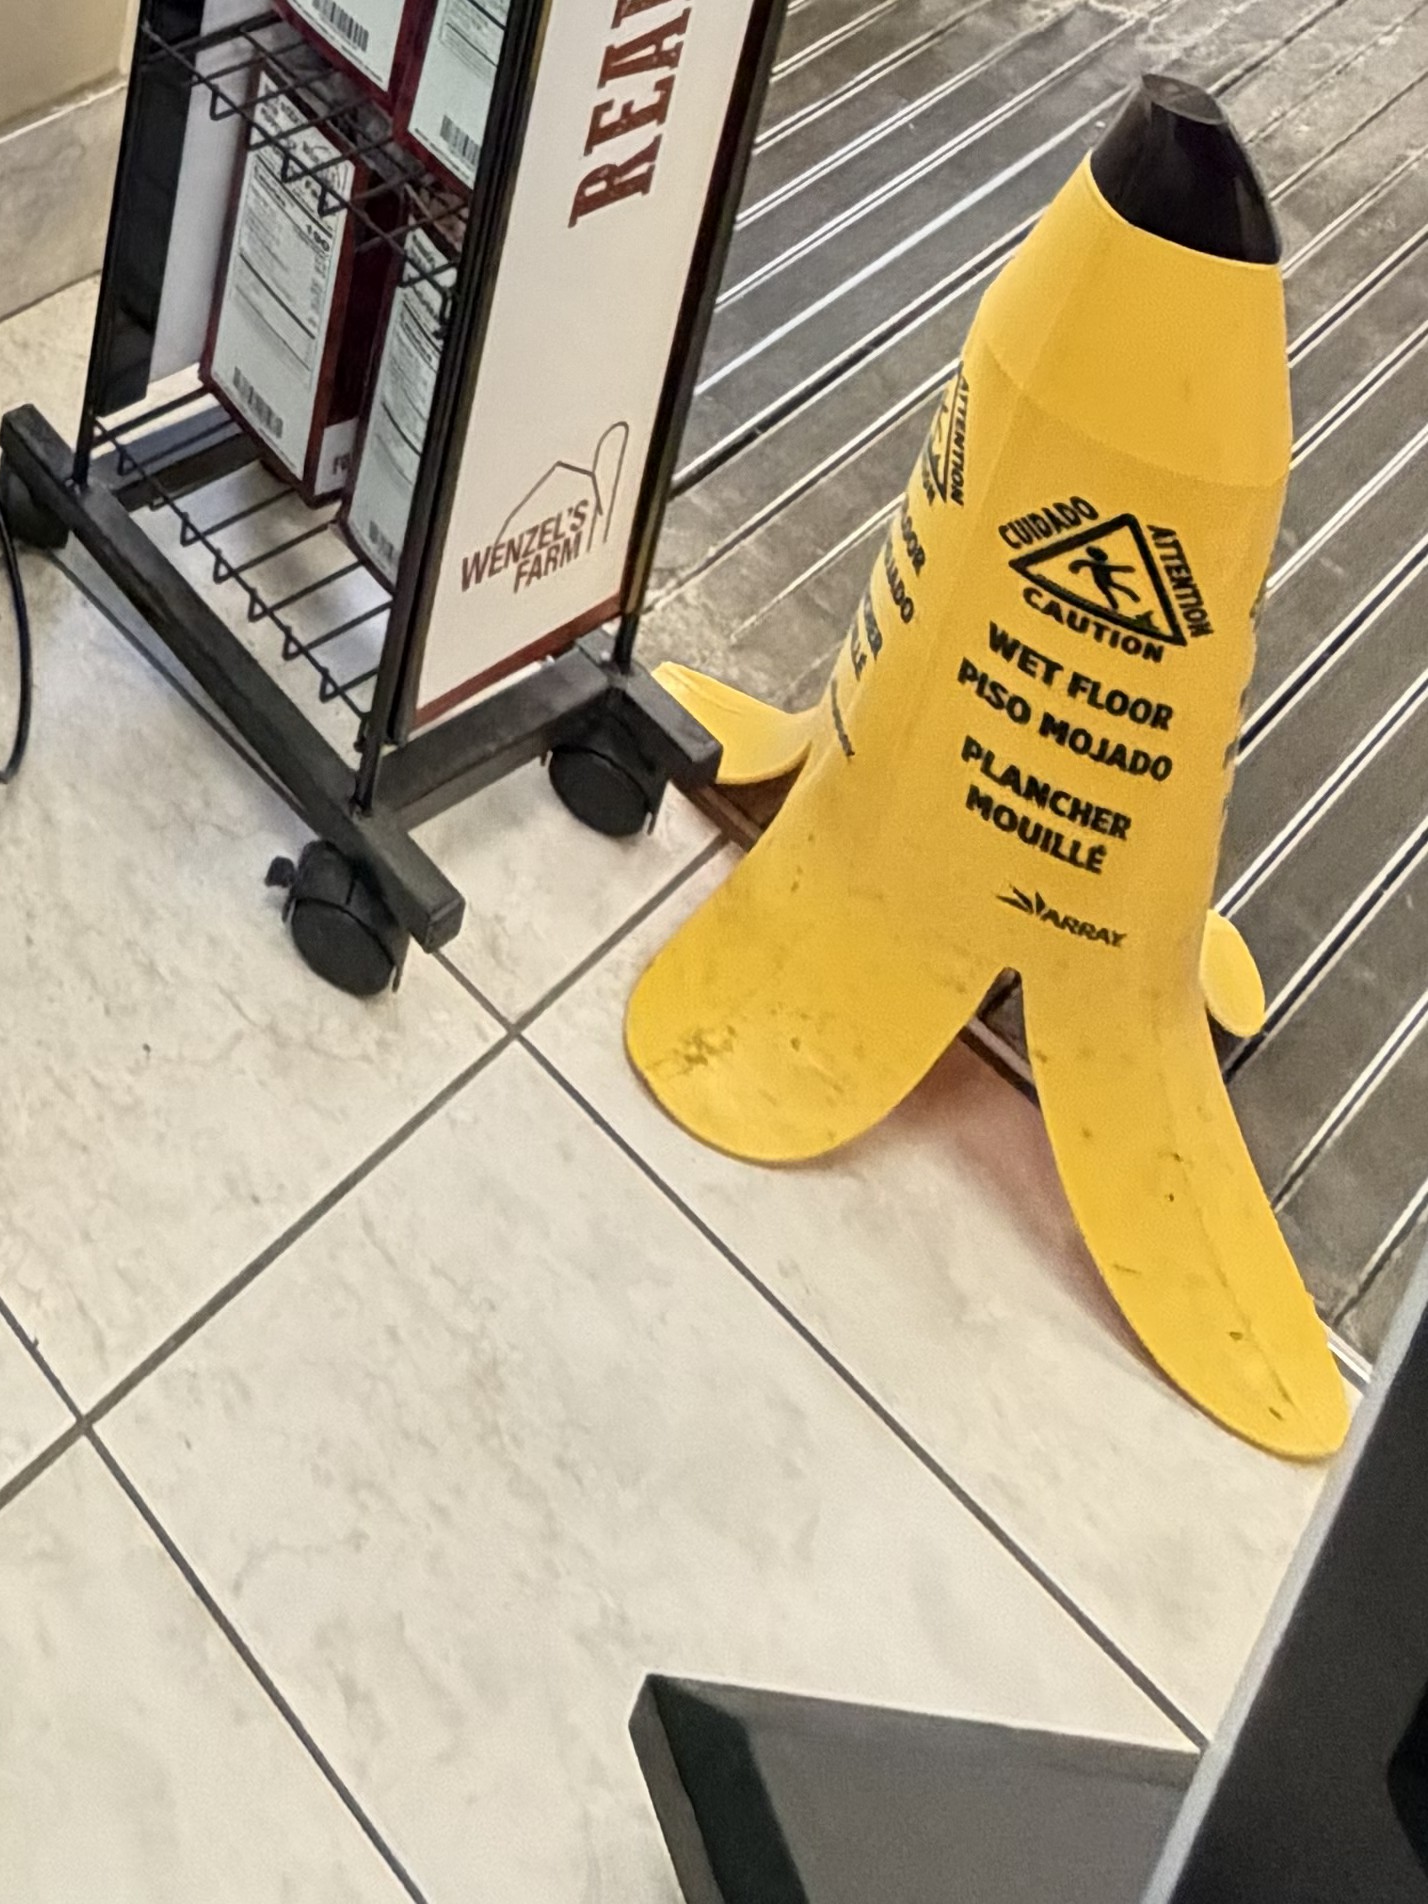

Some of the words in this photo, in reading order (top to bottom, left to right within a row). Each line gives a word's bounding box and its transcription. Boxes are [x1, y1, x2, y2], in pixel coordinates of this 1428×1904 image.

[462, 499, 589, 592] WENZEL'S
[513, 531, 582, 593] FARM
[998, 495, 1100, 551] CUIDADO
[1022, 587, 1166, 664] CAUTION
[1145, 525, 1215, 638] ATTENTION
[958, 658, 1032, 727] PISO
[1039, 712, 1173, 782] MOJADO
[987, 621, 1062, 689] WET
[1068, 671, 1175, 731] FLOOR
[961, 735, 1132, 843] PLANCHER
[965, 784, 1107, 875] MOUILLÉ
